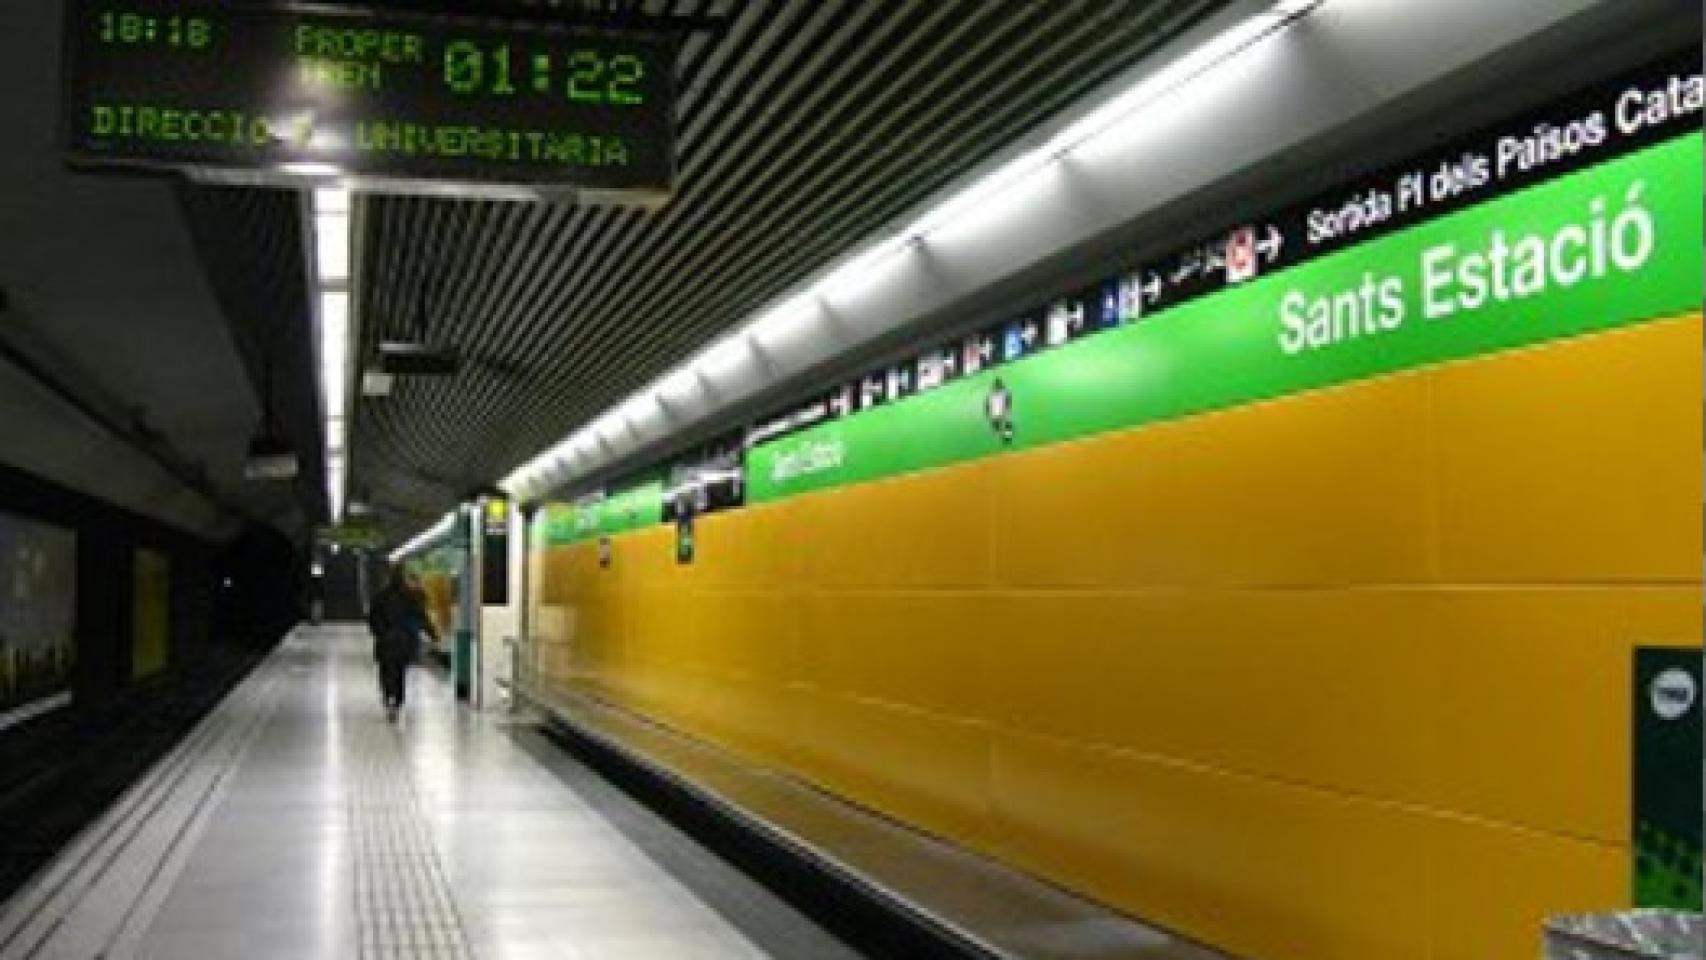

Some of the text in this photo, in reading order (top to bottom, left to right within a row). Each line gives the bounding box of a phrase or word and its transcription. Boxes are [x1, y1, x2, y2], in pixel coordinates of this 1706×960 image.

[99, 12, 209, 47] 18:18
[296, 25, 422, 61] PROPER
[444, 41, 645, 105] 01:22
[1306, 188, 1393, 244] Sortida
[1430, 152, 1489, 201] dels
[1278, 182, 1655, 355] Sants Estació
